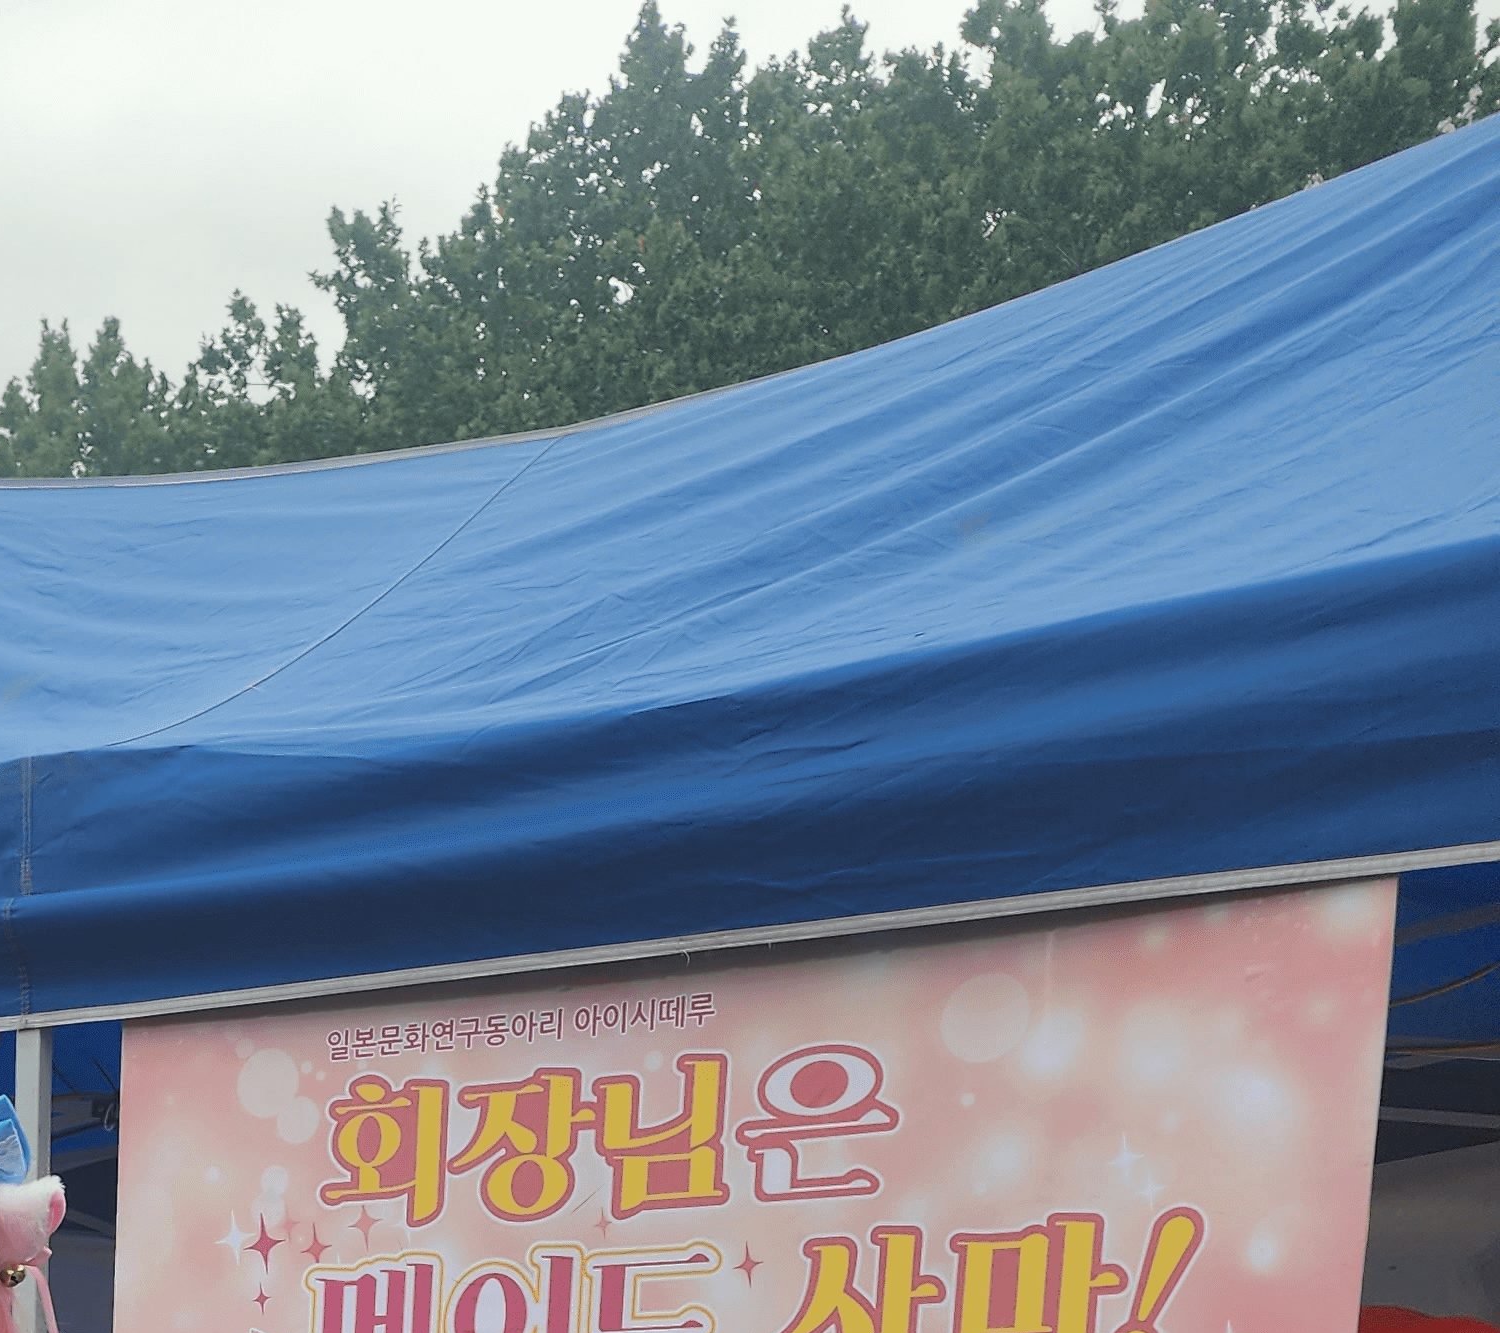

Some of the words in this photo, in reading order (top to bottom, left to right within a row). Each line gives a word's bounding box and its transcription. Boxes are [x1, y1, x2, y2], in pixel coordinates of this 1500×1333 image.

[326, 1007, 565, 1061] 일본문화연구동아리
[573, 992, 716, 1037] 아이시떼루
[319, 1043, 901, 1228] 회장님은
